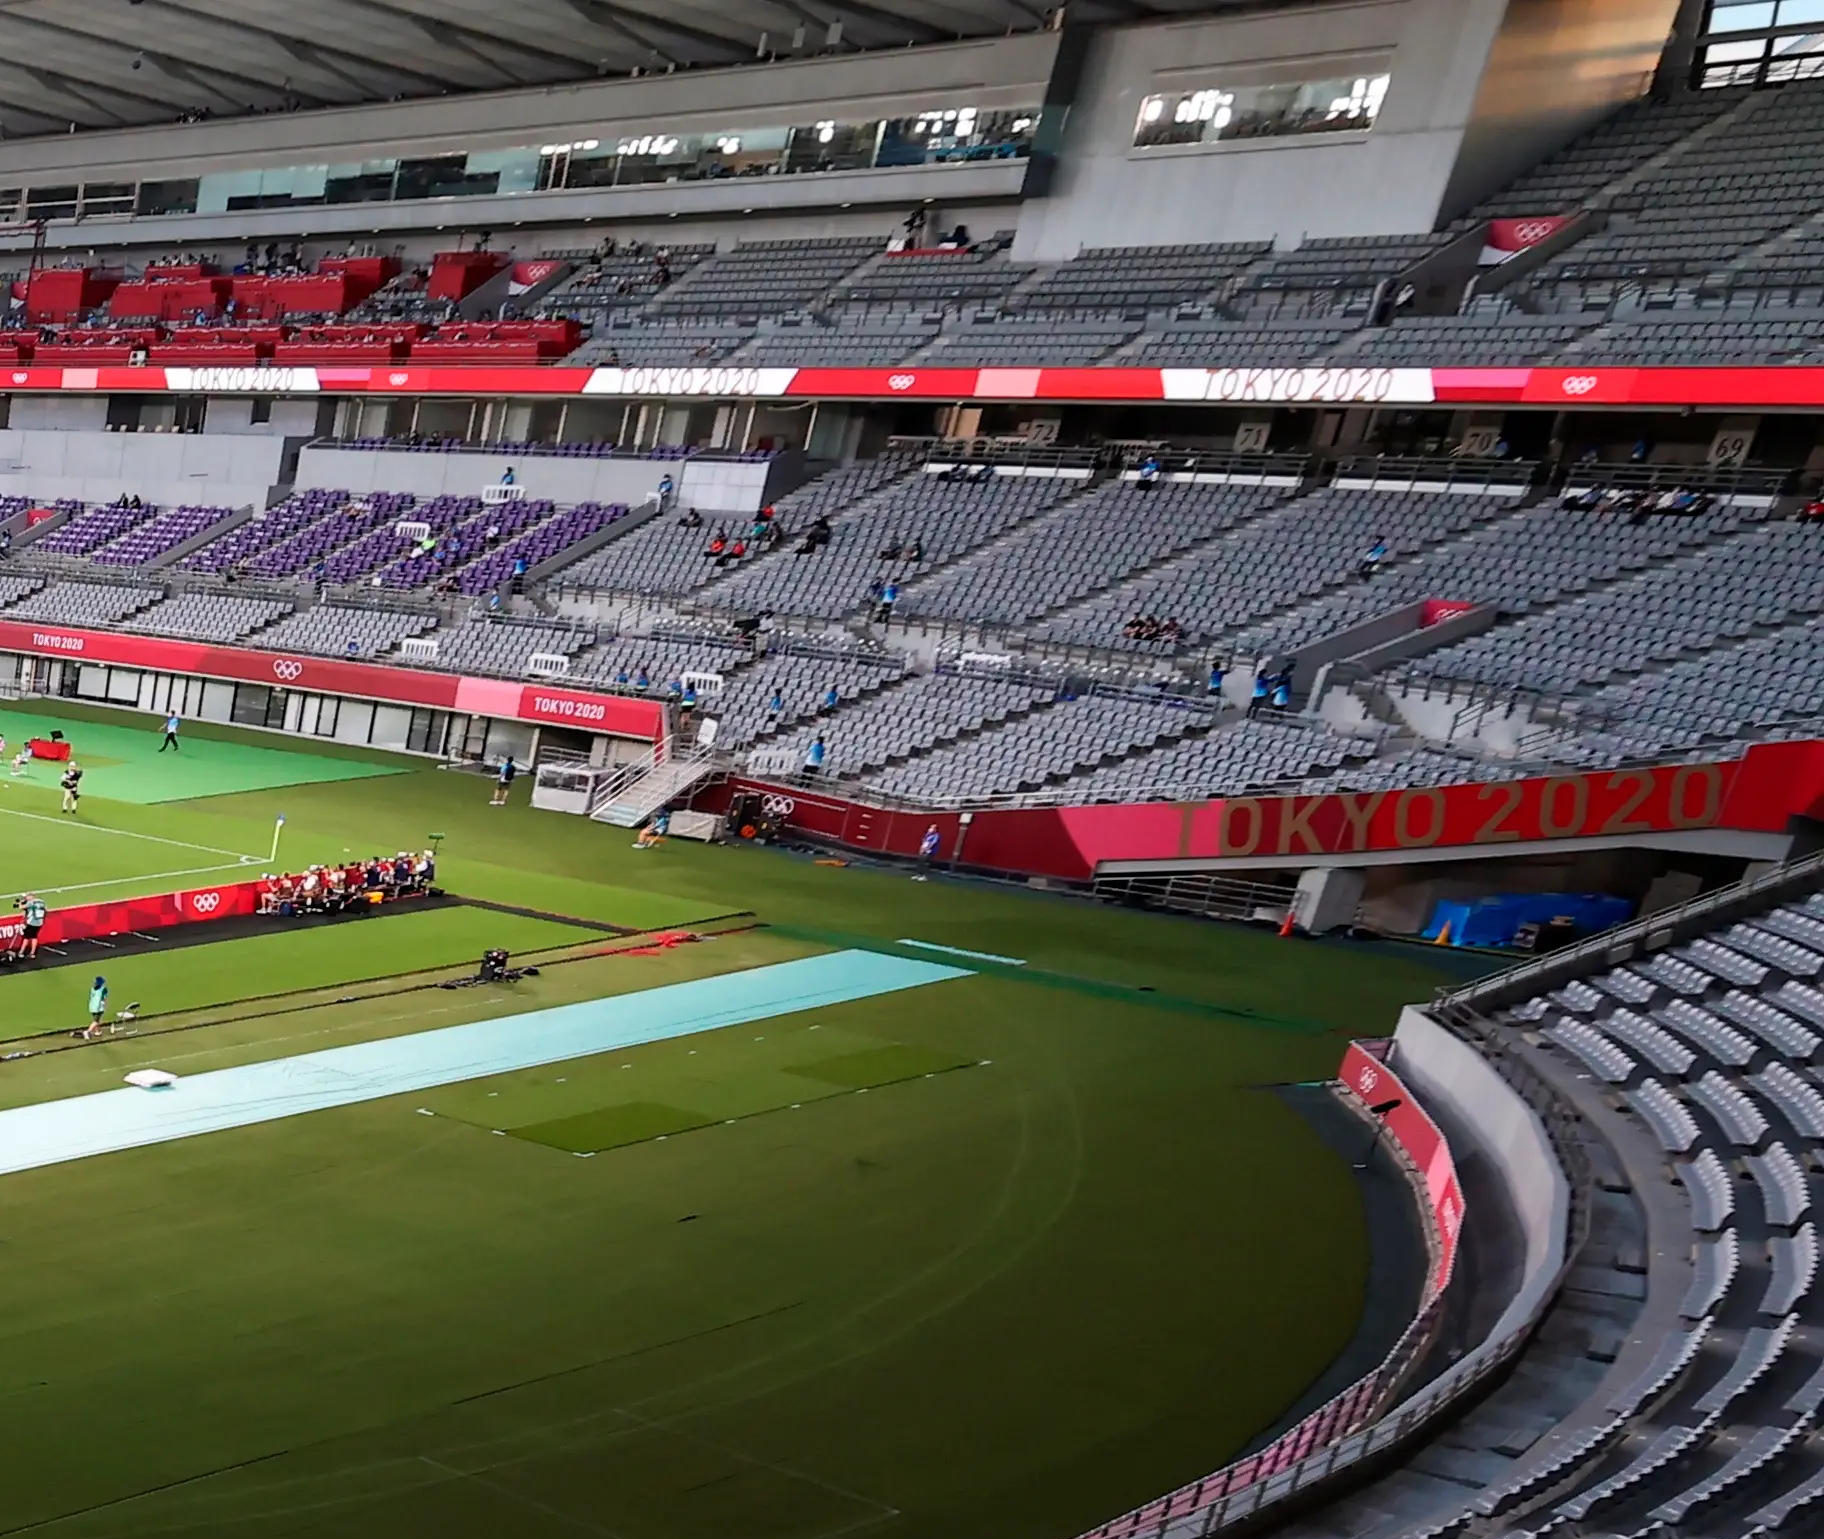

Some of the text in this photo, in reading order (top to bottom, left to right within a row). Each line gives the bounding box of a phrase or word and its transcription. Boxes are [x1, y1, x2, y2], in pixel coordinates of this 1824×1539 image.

[189, 367, 295, 390] TOKYO 2020
[619, 367, 759, 394] TOKYO 2020
[1203, 368, 1393, 401] TOKYO 2020
[1239, 427, 1262, 446] 71
[1466, 434, 1493, 452] 70
[1715, 437, 1745, 458] 69
[32, 632, 84, 650] TOKYO 2020
[534, 696, 605, 719] TOKYO 2020
[1169, 763, 1722, 857] TOKYO 2020
